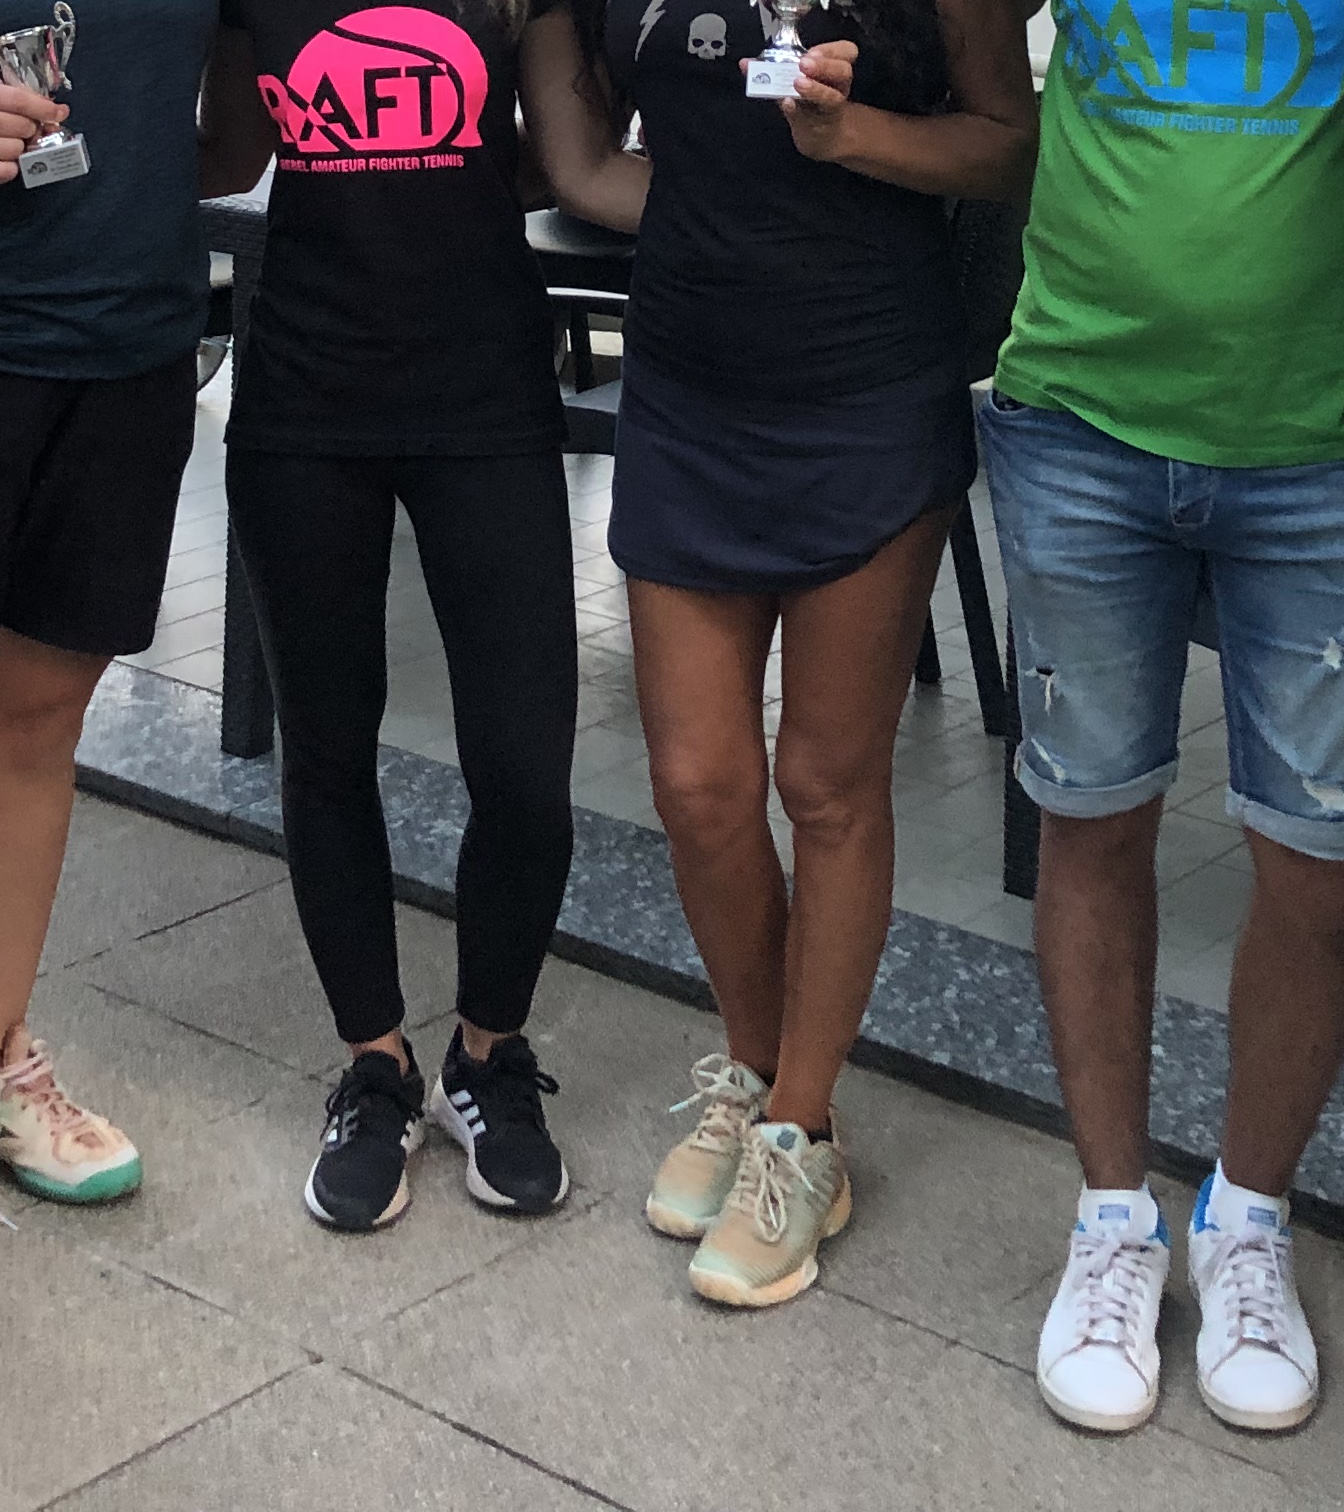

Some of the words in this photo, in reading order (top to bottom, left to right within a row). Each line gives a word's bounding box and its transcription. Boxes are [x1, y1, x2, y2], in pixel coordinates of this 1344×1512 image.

[310, 157, 366, 173] AMATEUR
[369, 156, 420, 171] FIGHTER
[422, 154, 465, 169] TENNIS
